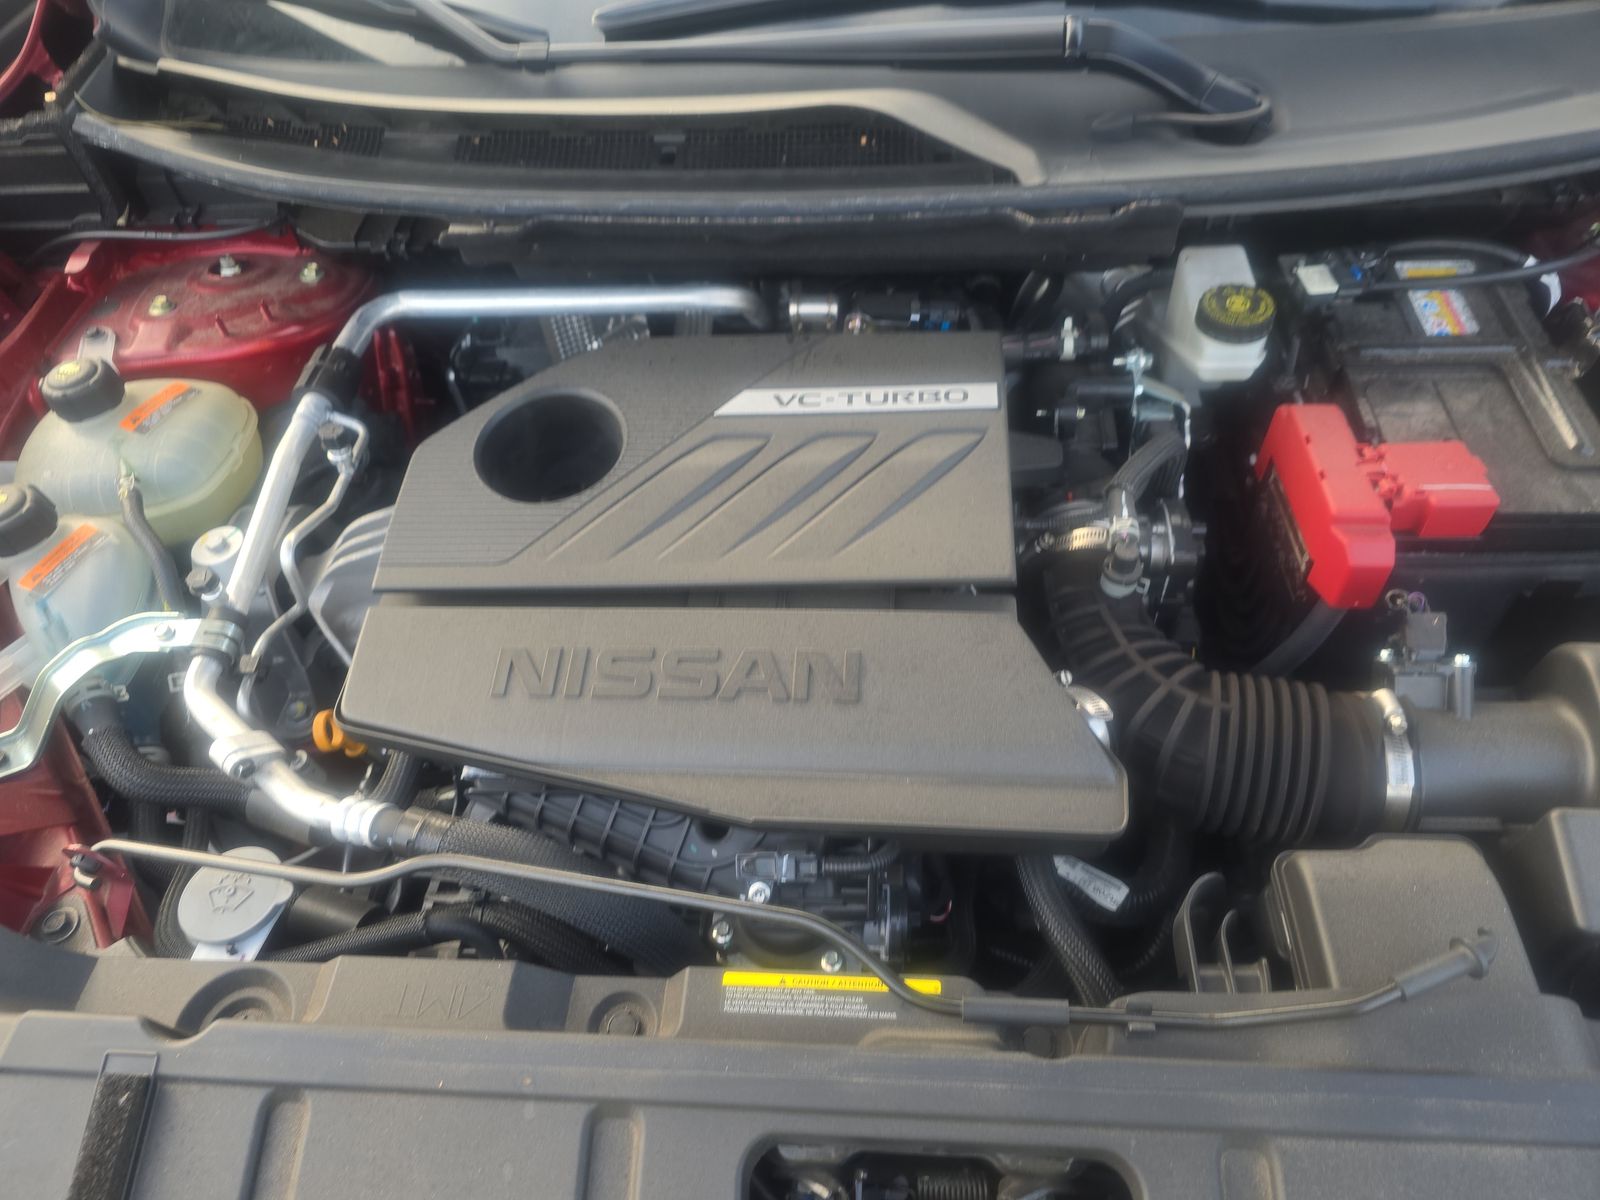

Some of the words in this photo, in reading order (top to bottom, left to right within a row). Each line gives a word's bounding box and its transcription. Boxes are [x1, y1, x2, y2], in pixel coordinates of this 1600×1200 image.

[773, 387, 969, 408] VC-TURBO
[489, 646, 864, 705] NISSAN
[792, 978, 830, 986] CAUTION
